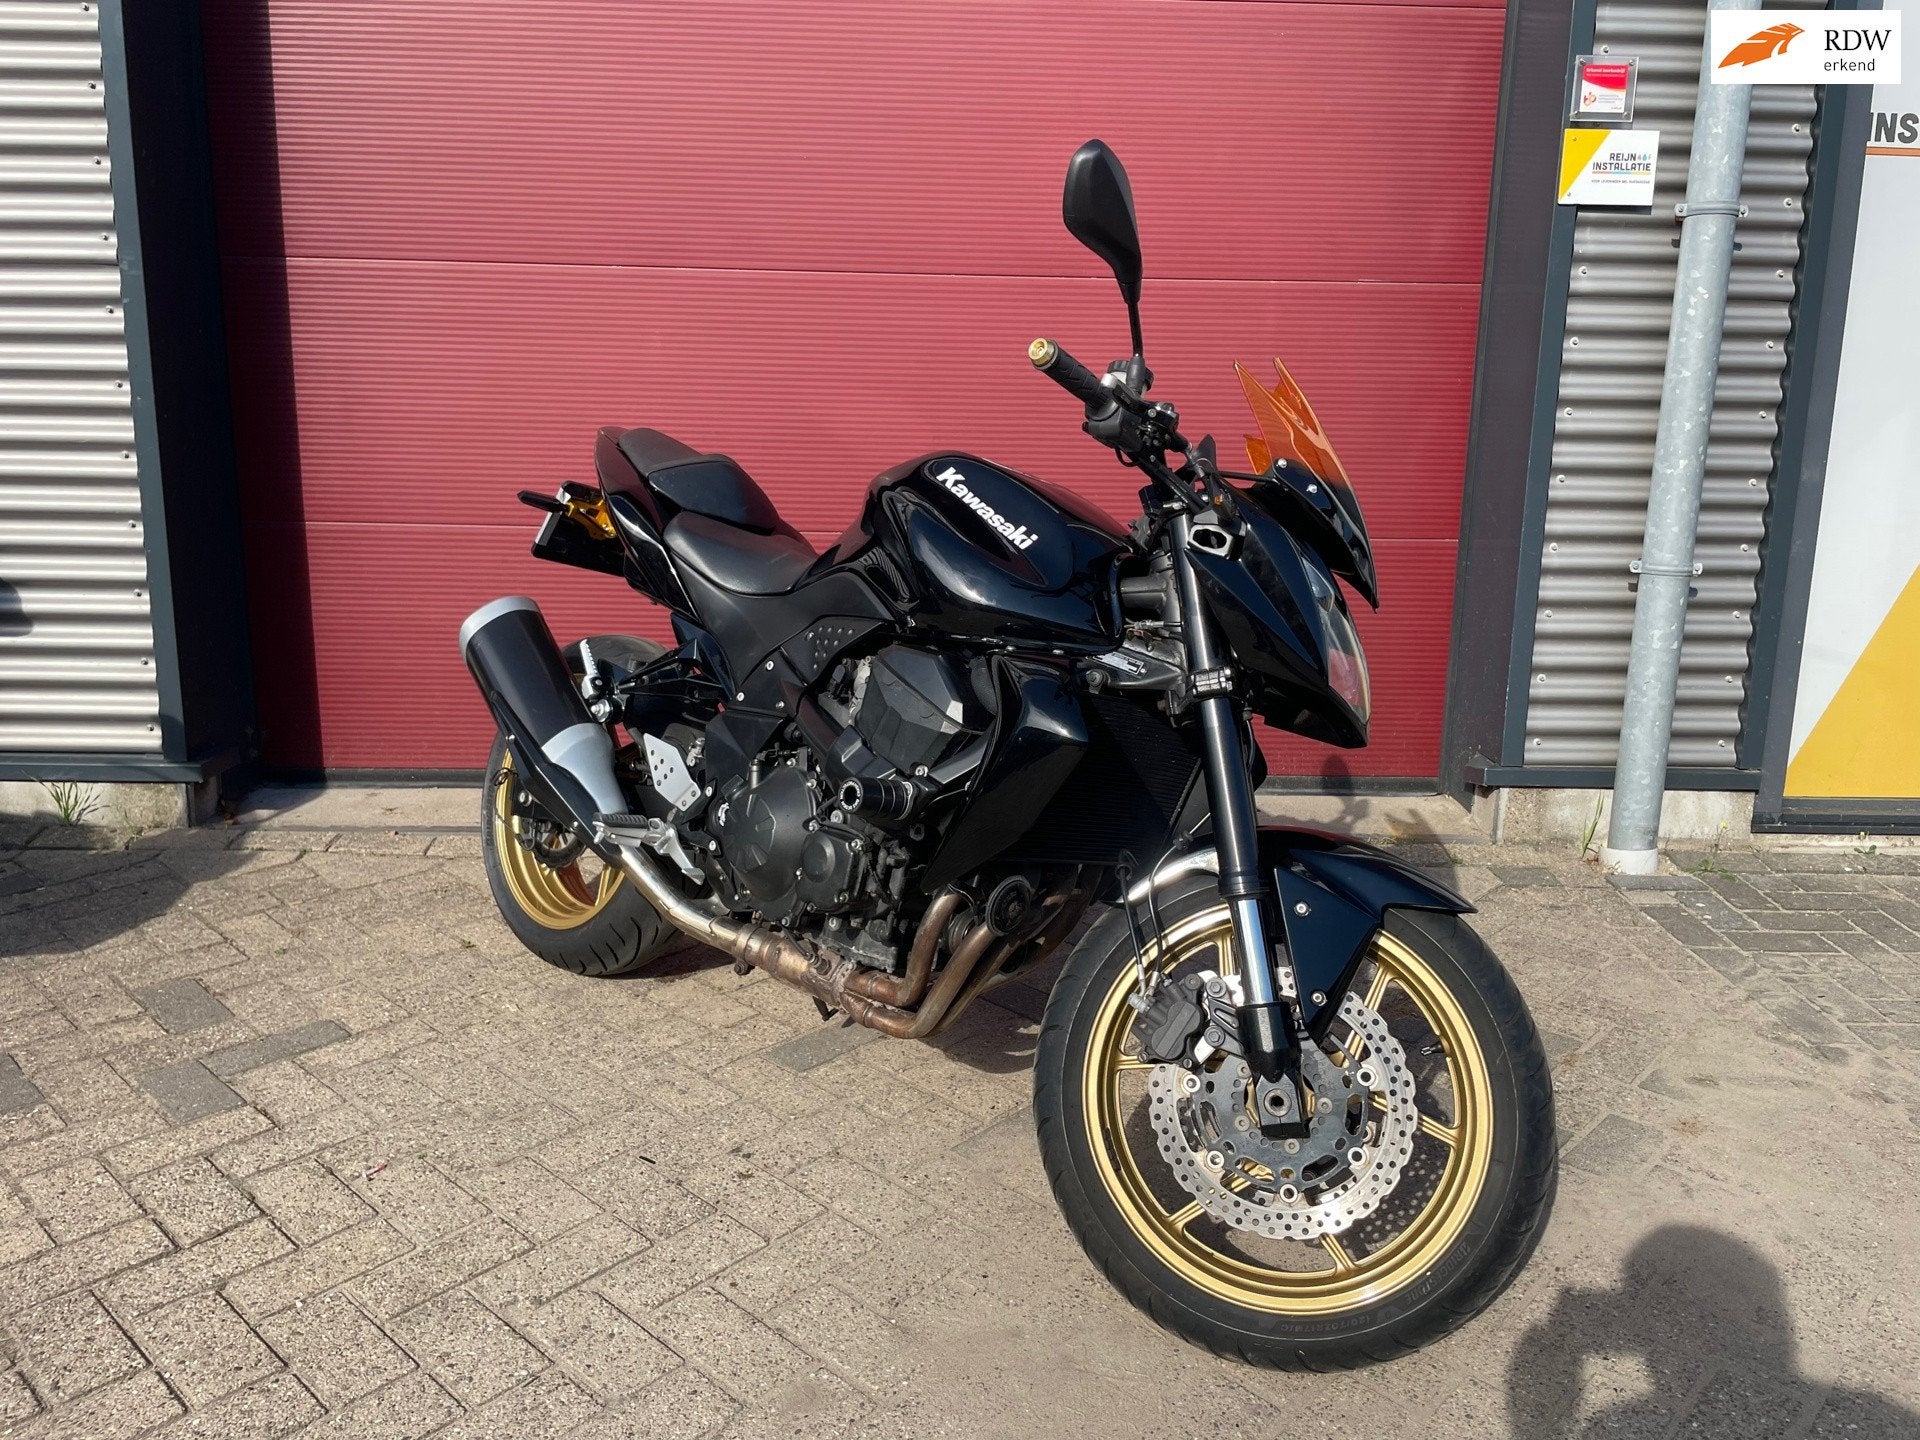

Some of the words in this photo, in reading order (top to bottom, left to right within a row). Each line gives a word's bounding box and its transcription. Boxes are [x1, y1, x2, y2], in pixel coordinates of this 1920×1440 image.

[1609, 152, 1637, 161] REIJN
[1592, 162, 1651, 171] INSTALLATIE
[936, 466, 1039, 550] Kawasaki
